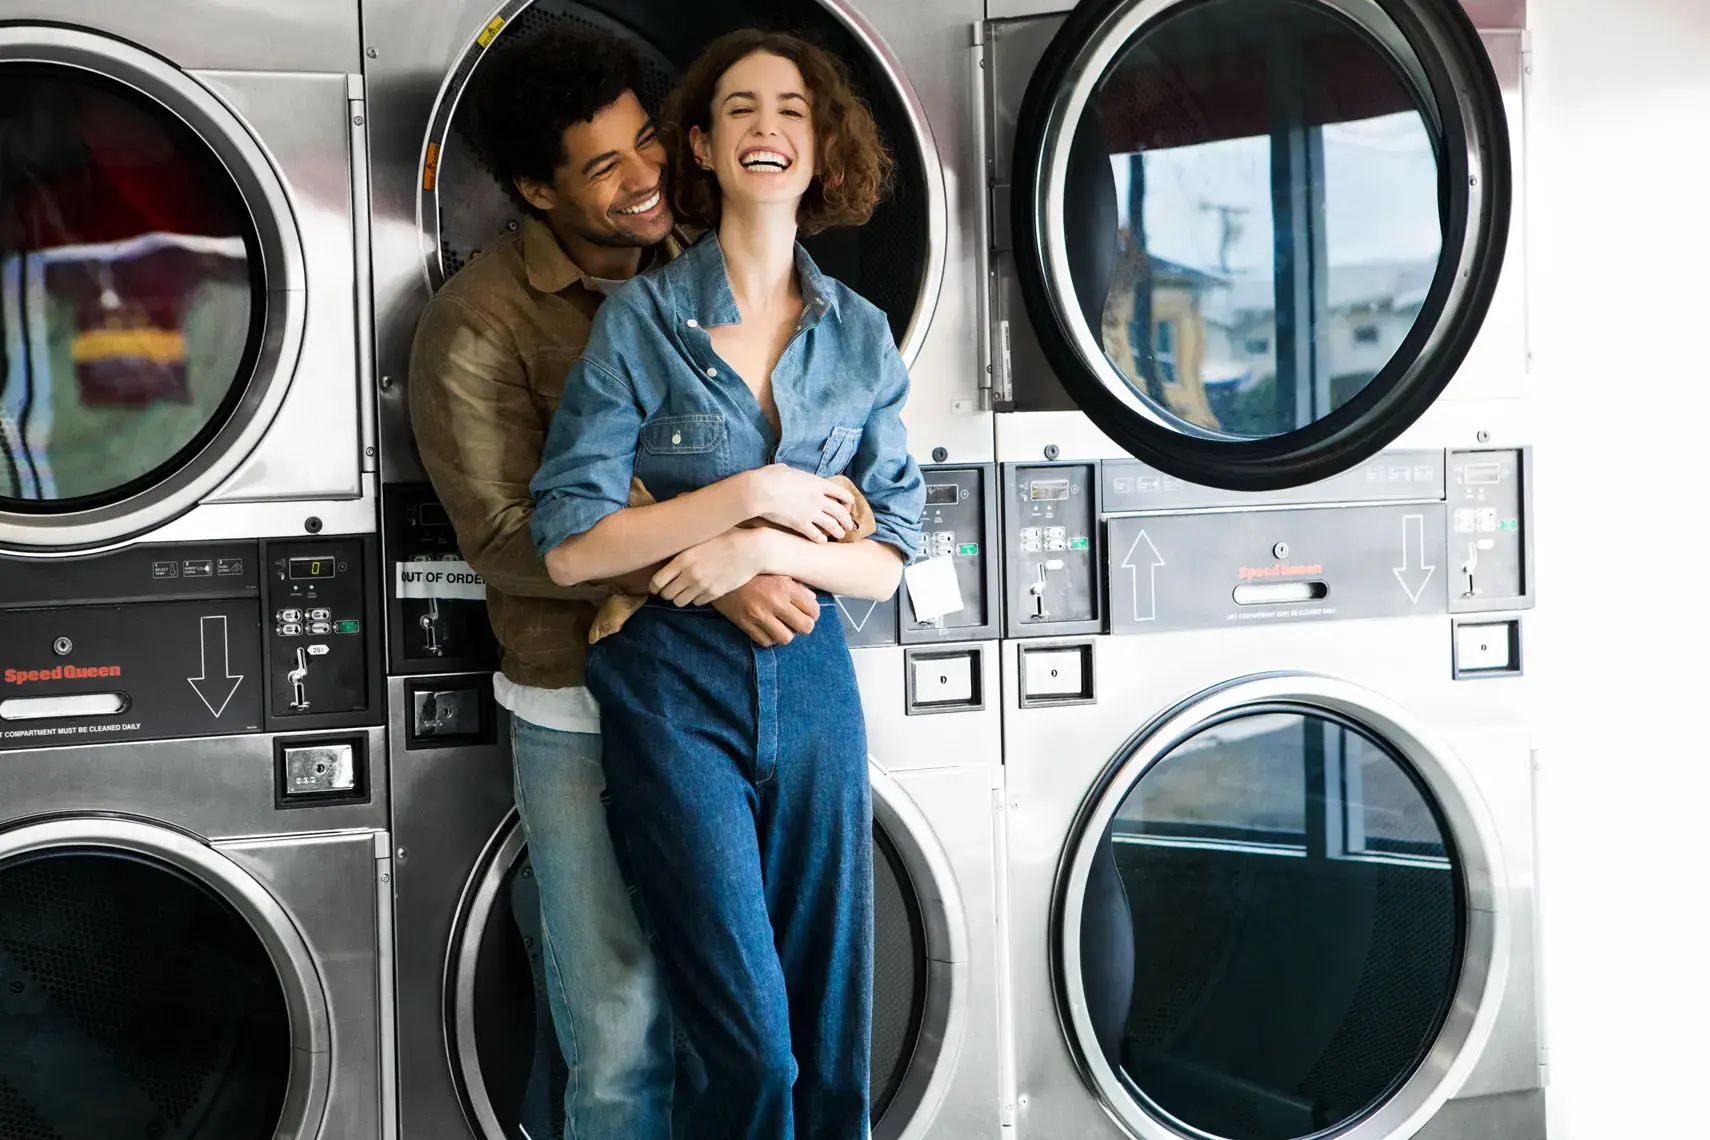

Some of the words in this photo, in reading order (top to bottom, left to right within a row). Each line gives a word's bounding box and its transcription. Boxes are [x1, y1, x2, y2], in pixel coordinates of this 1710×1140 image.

[312, 562, 320, 574] 0
[401, 571, 423, 583] OUT
[425, 572, 443, 583] OF
[4, 665, 62, 685] Speed
[63, 664, 121, 679] Queen
[4, 728, 56, 738] COMPARTMENT
[57, 726, 77, 735] MUST
[78, 725, 88, 733] BE
[89, 723, 121, 733] CLEANED
[122, 722, 141, 731] DAILY
